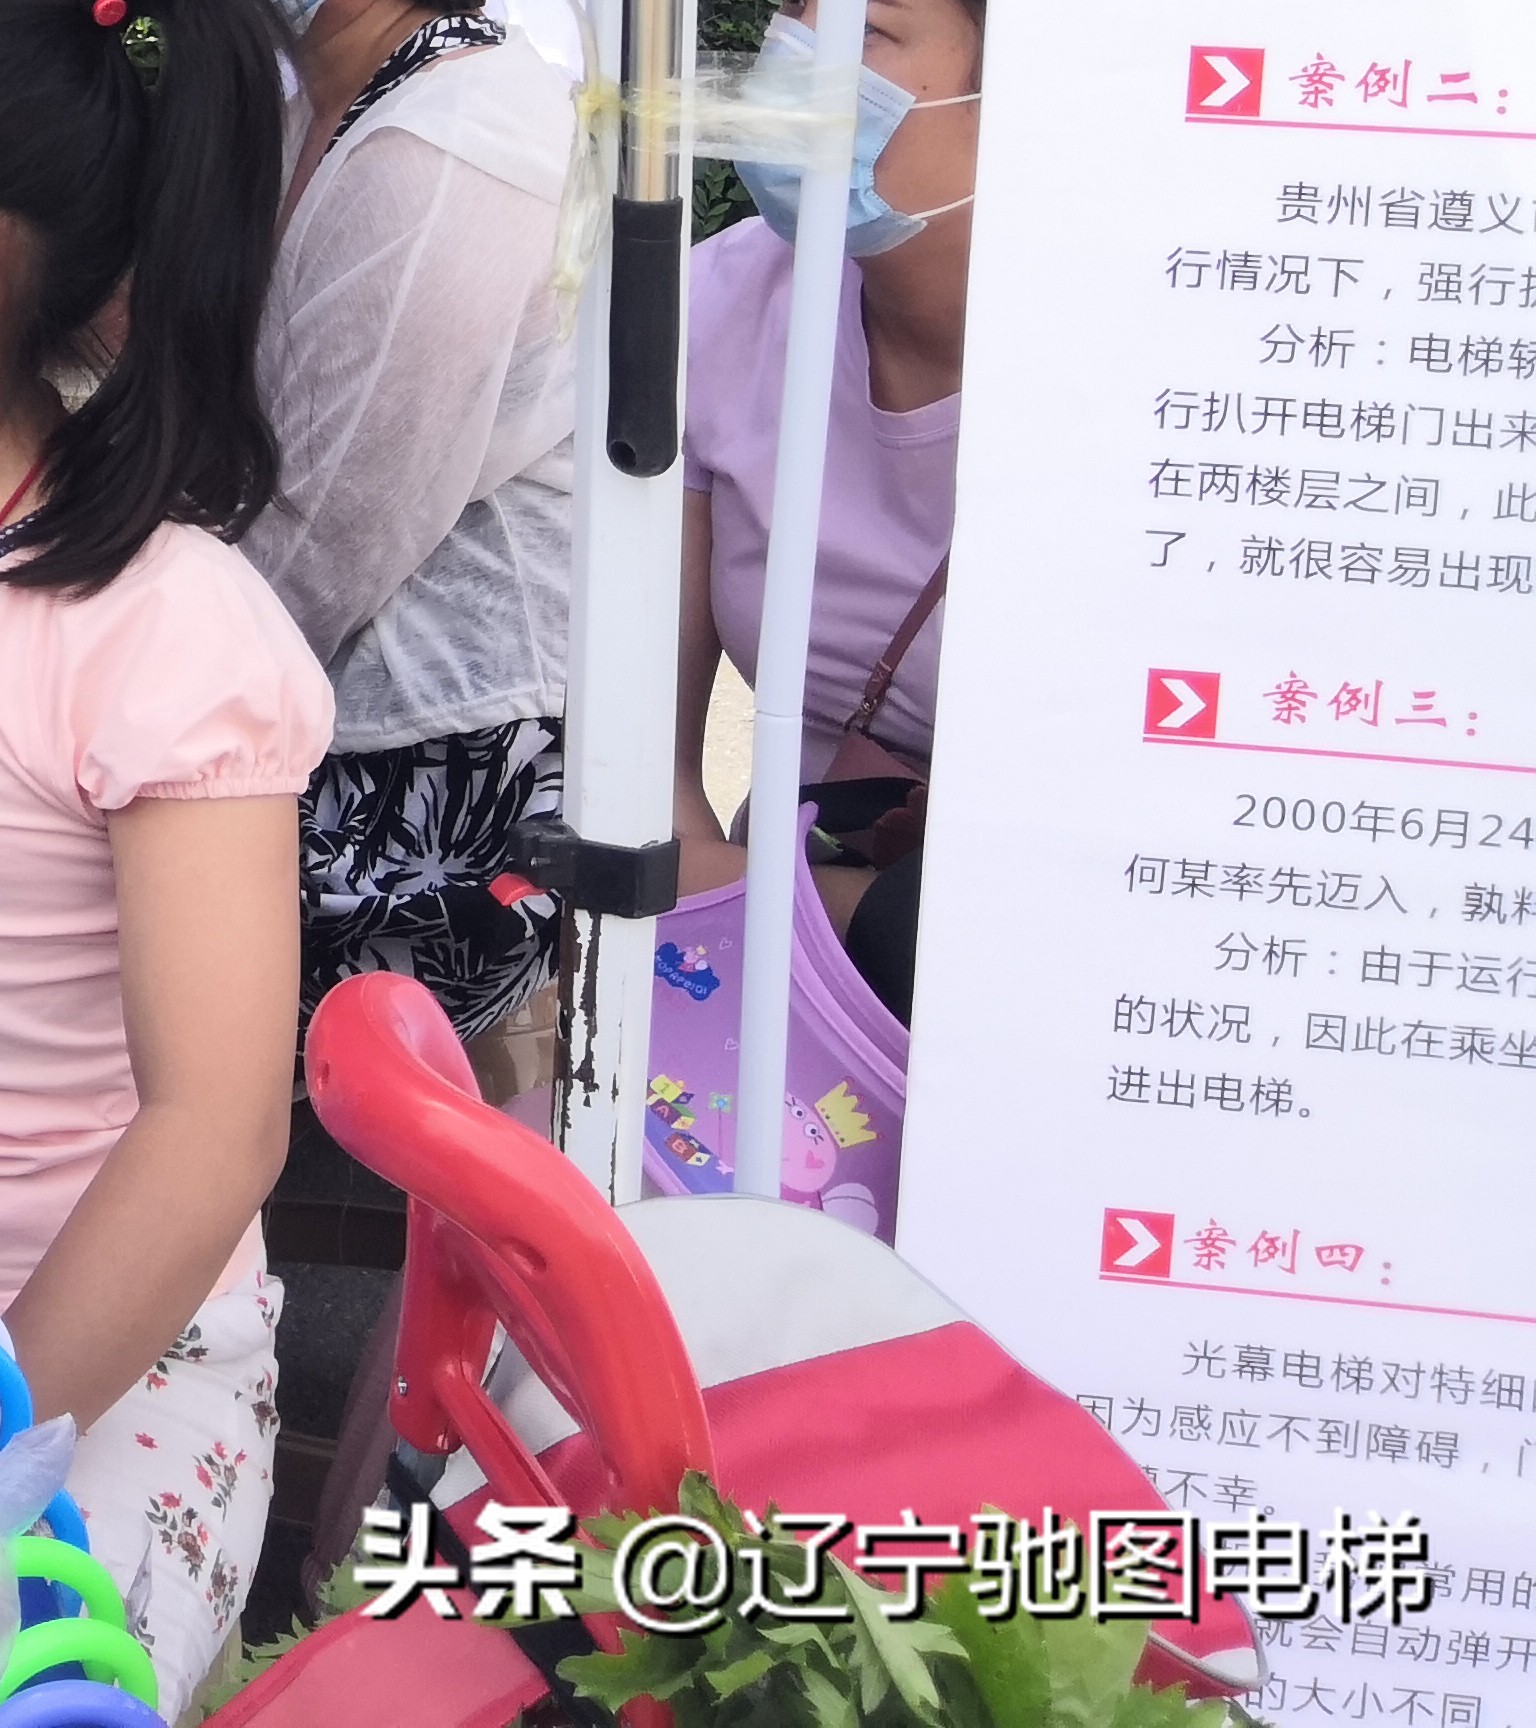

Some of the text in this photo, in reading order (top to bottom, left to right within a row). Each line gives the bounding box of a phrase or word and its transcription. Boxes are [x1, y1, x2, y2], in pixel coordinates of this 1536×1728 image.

[1288, 52, 1509, 116] 案例二：
[1276, 181, 1536, 235] 贵州省遵义
[1153, 388, 1536, 453] 行扒开电梯门出来
[1148, 457, 1536, 525] 在两楼层之间，此
[1145, 529, 1534, 595] 了，就很容易出现
[1262, 670, 1479, 737] 案例三：
[1113, 992, 1536, 1069] 的状况，因此在乘坐
[1106, 1064, 1310, 1120] 进出电梯。
[1183, 1218, 1393, 1286] 案例四：
[1182, 1339, 1536, 1412] 光幕电梯对特细
[1140, 1465, 1276, 1518] 不幸。
